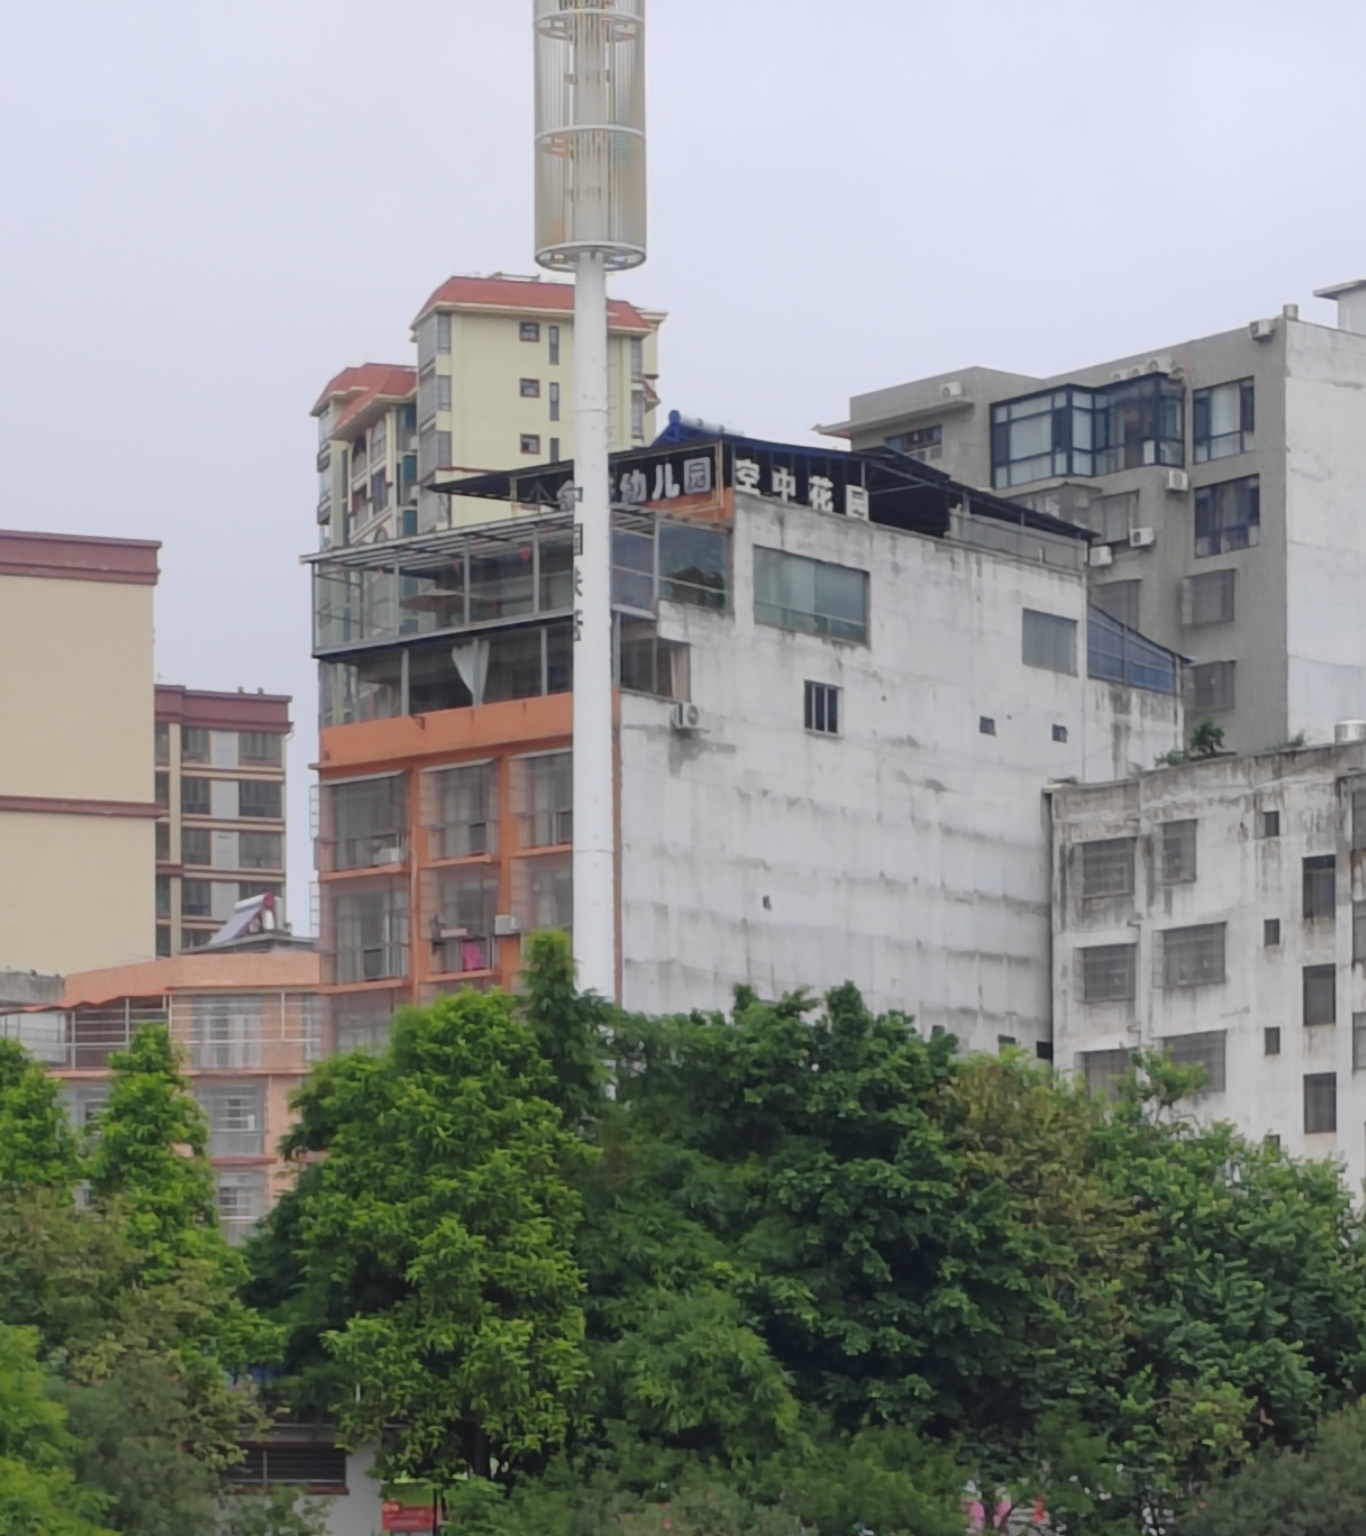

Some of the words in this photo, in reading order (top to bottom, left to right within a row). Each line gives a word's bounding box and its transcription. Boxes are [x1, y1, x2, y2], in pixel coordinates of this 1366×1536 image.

[557, 456, 711, 510] 幼儿园
[735, 459, 870, 521] 空中花园
